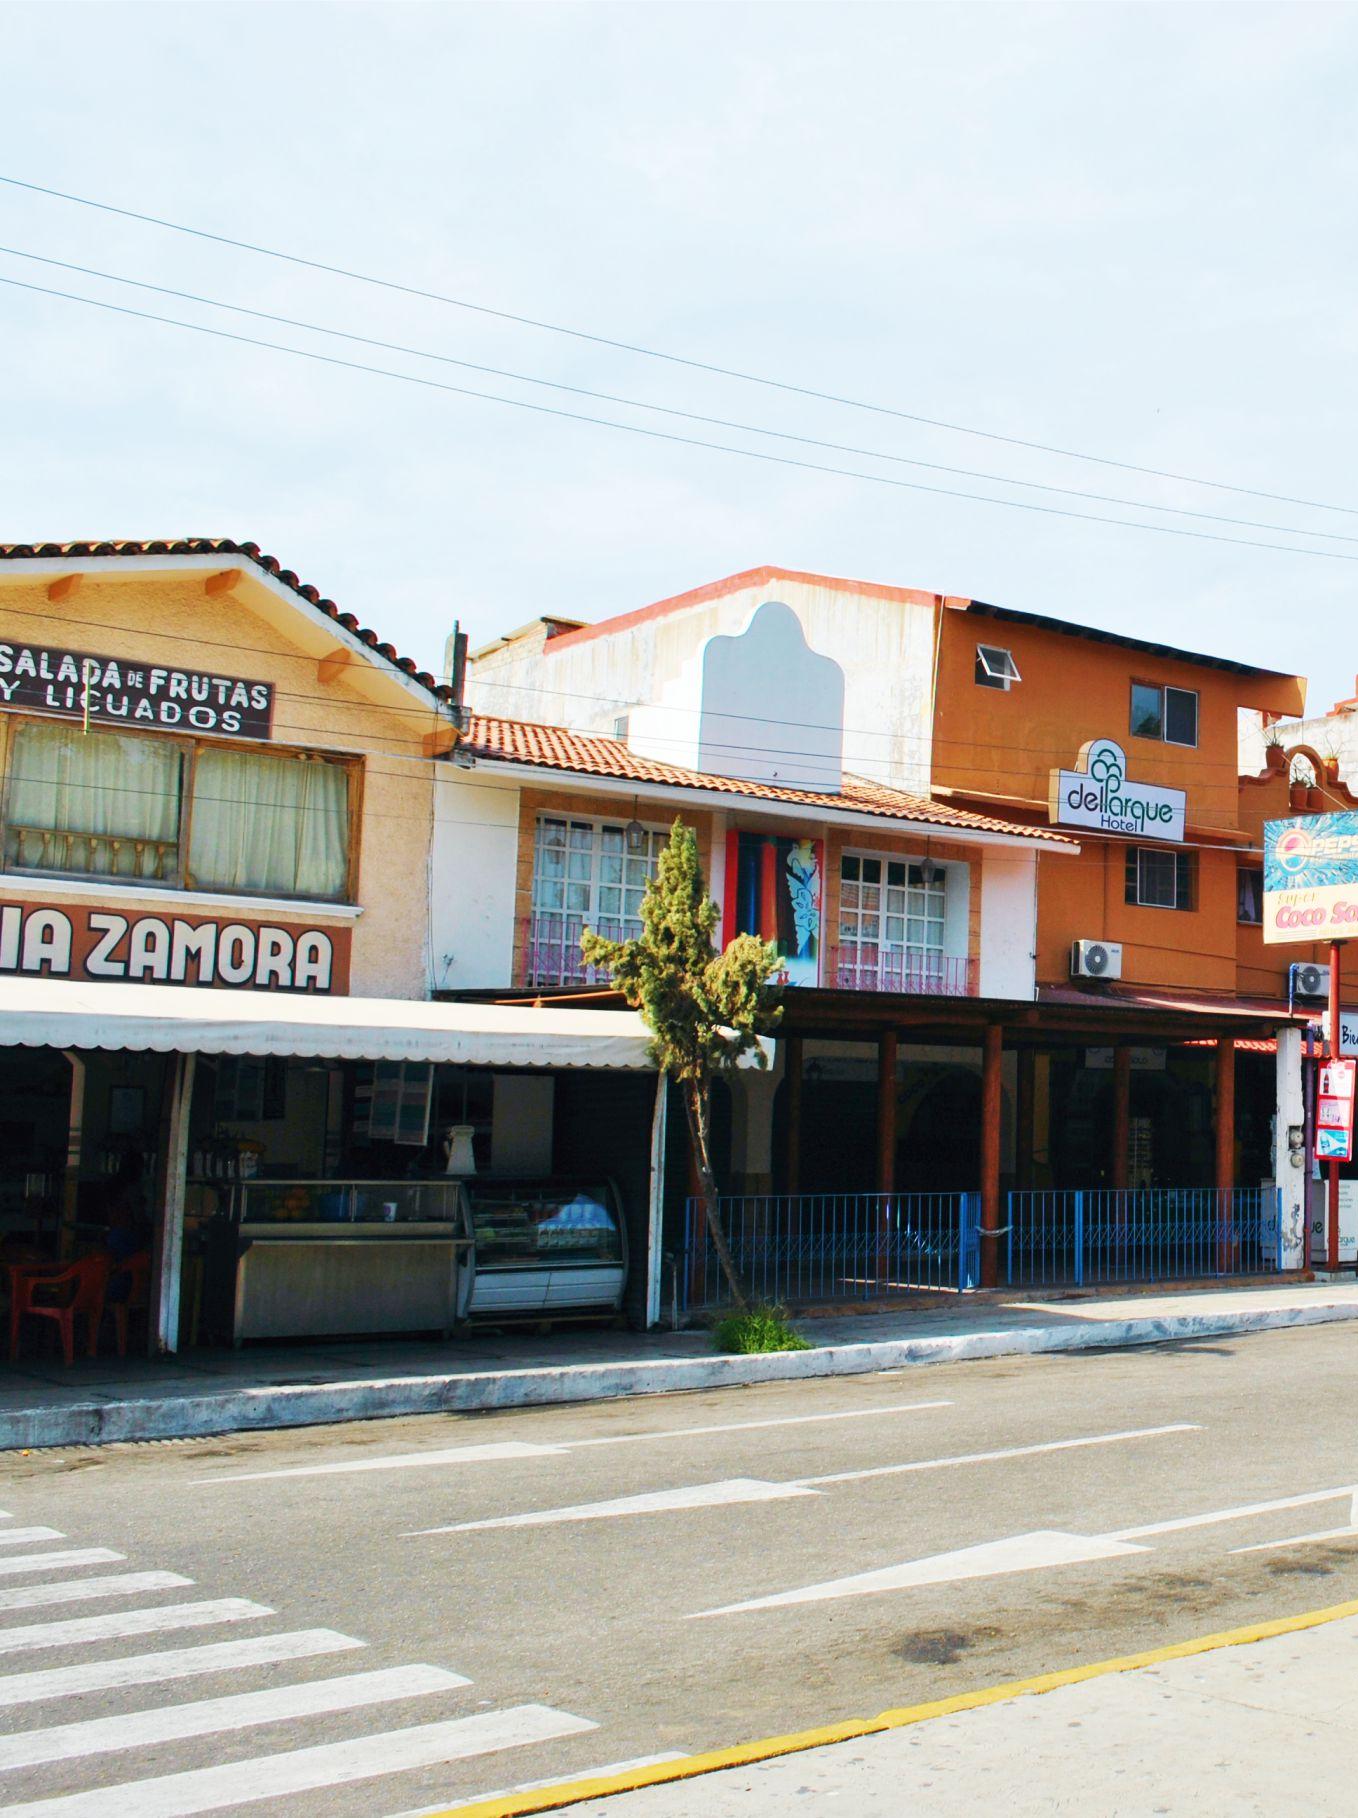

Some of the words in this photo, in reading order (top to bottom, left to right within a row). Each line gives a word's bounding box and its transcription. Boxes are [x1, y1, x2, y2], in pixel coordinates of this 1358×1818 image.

[0, 644, 122, 689] SALADA
[127, 670, 144, 689] DE
[150, 668, 268, 710] FRUTAS
[0, 677, 21, 700] Y
[46, 683, 242, 732] LICUADOS
[1101, 814, 1137, 832] Hotel
[84, 911, 334, 993] ZAMORA
